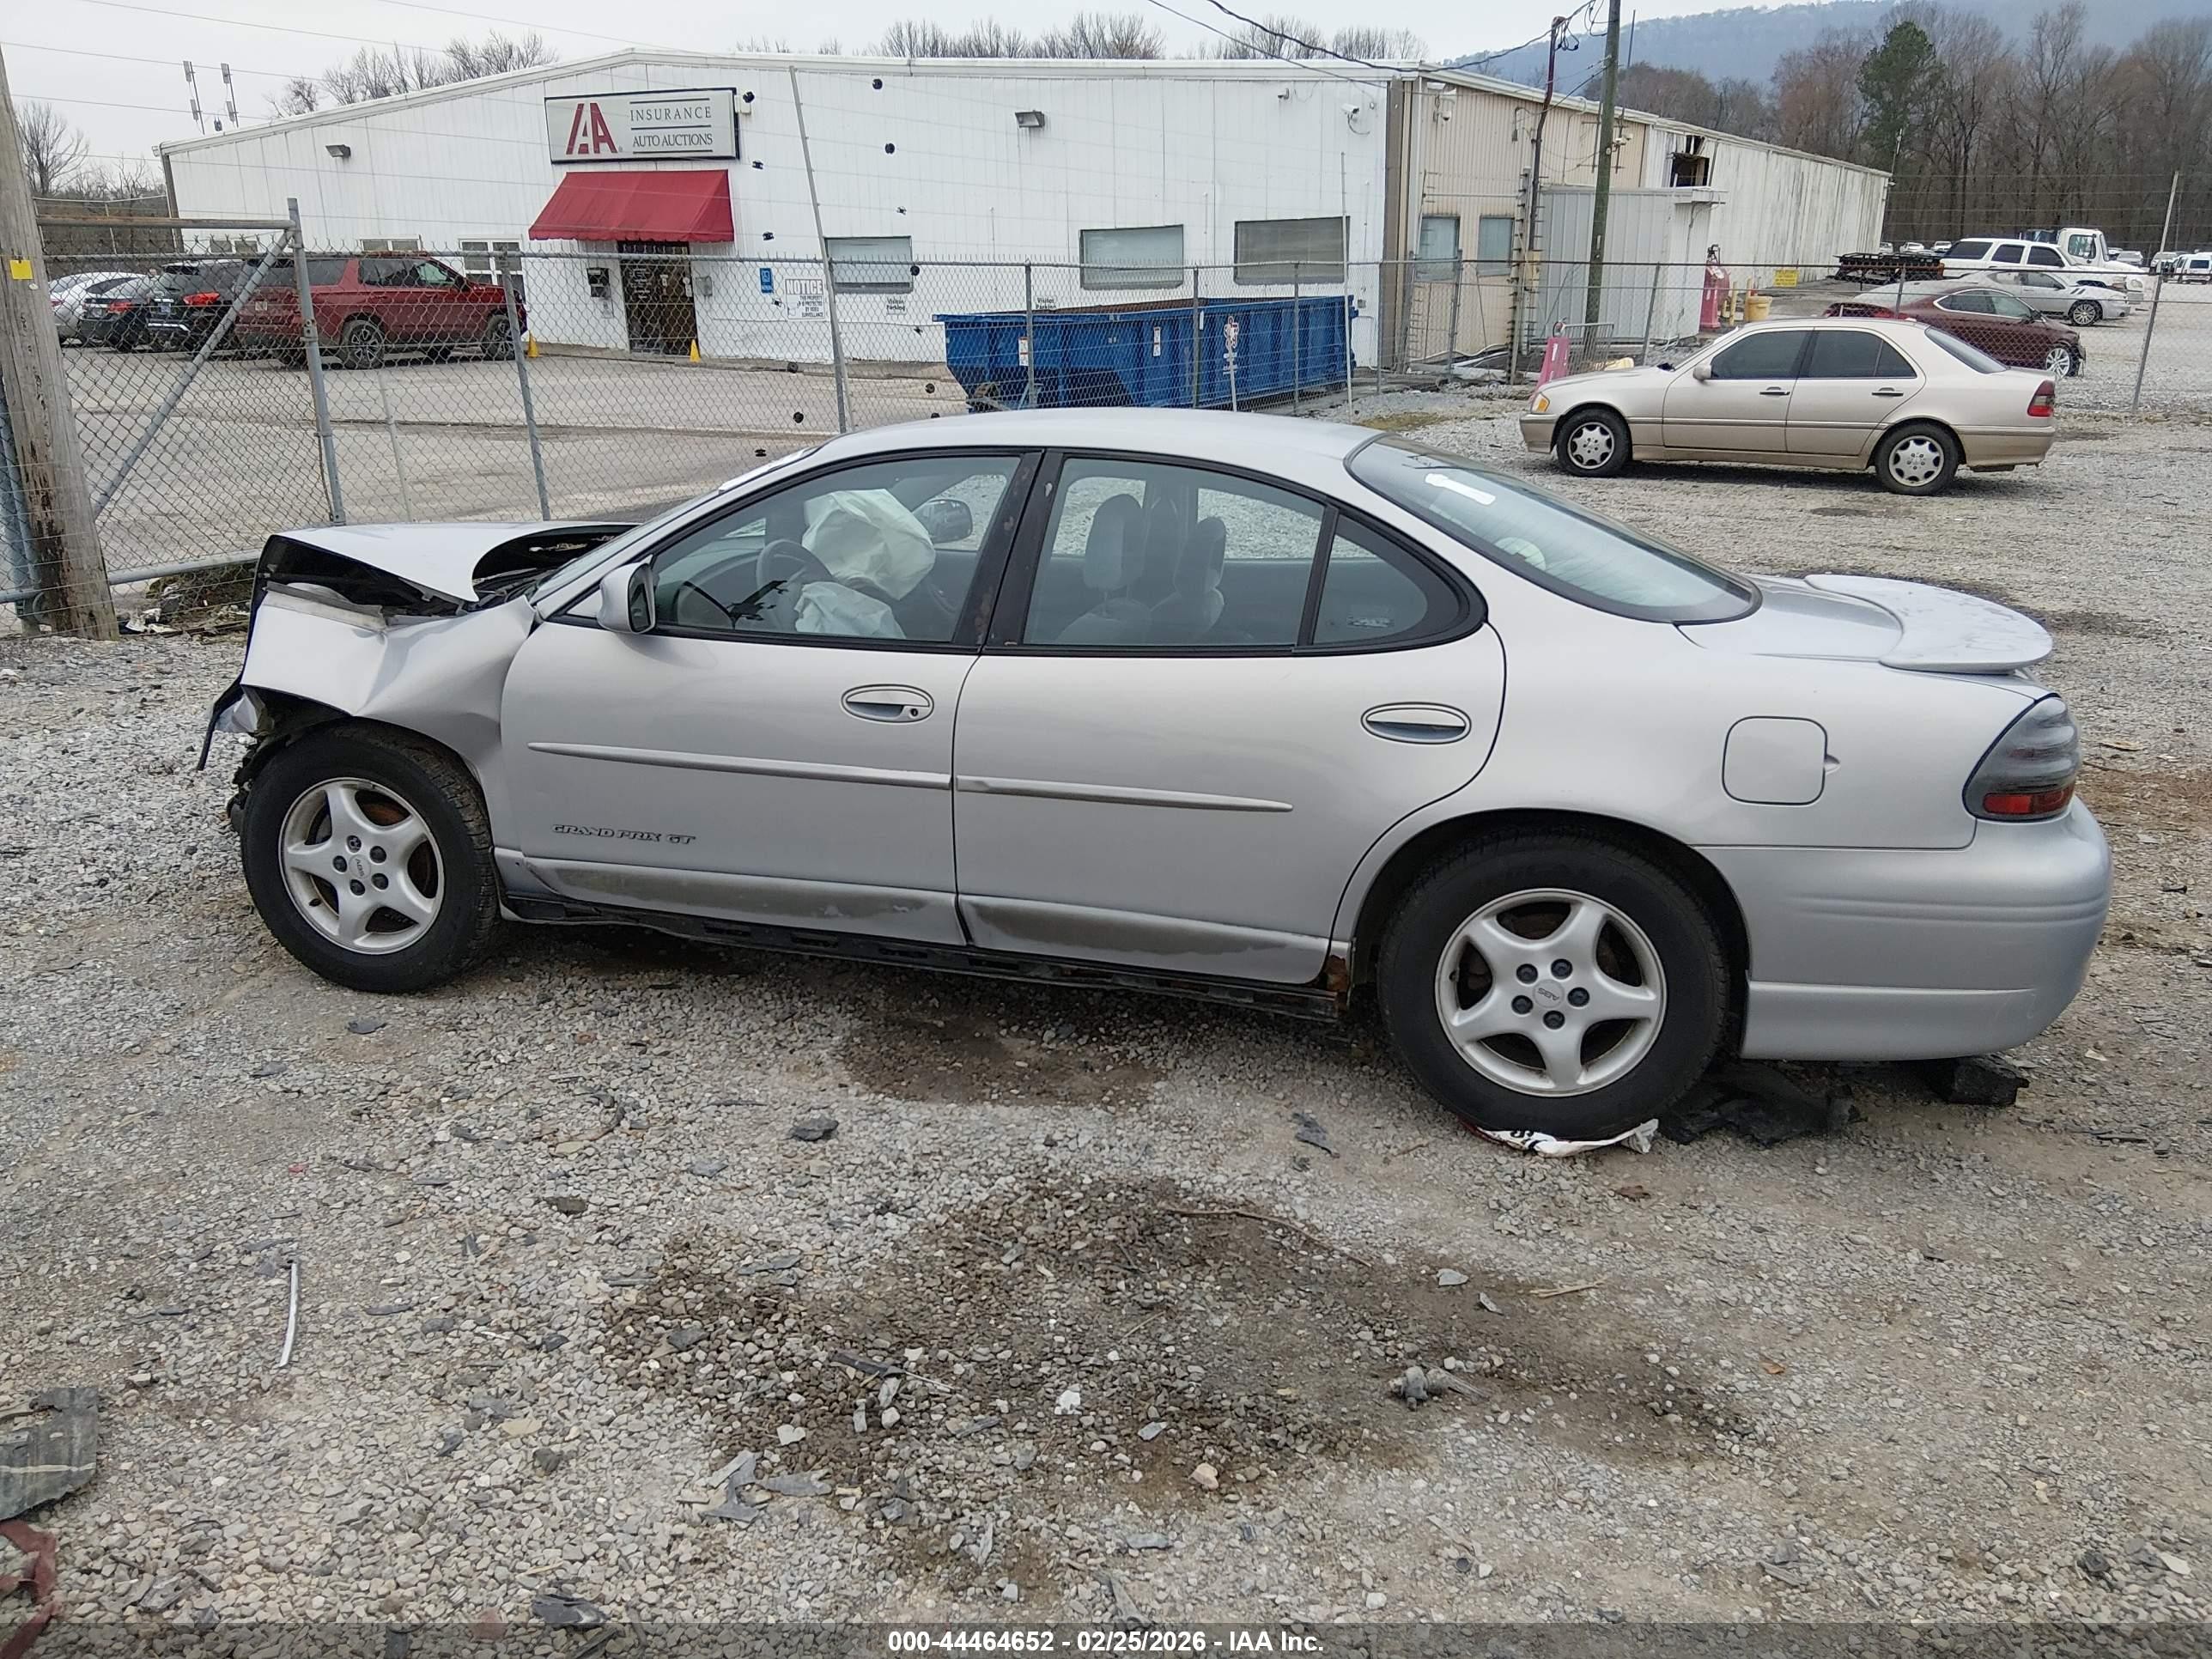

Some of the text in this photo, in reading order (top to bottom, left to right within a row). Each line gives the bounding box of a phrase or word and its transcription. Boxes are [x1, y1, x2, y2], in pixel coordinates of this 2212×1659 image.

[629, 106, 713, 121] INSURANCE
[632, 132, 714, 148] AUTO AUCTIONS
[786, 279, 823, 295] NOTICE
[551, 823, 696, 845] GRAND PRIX GT
